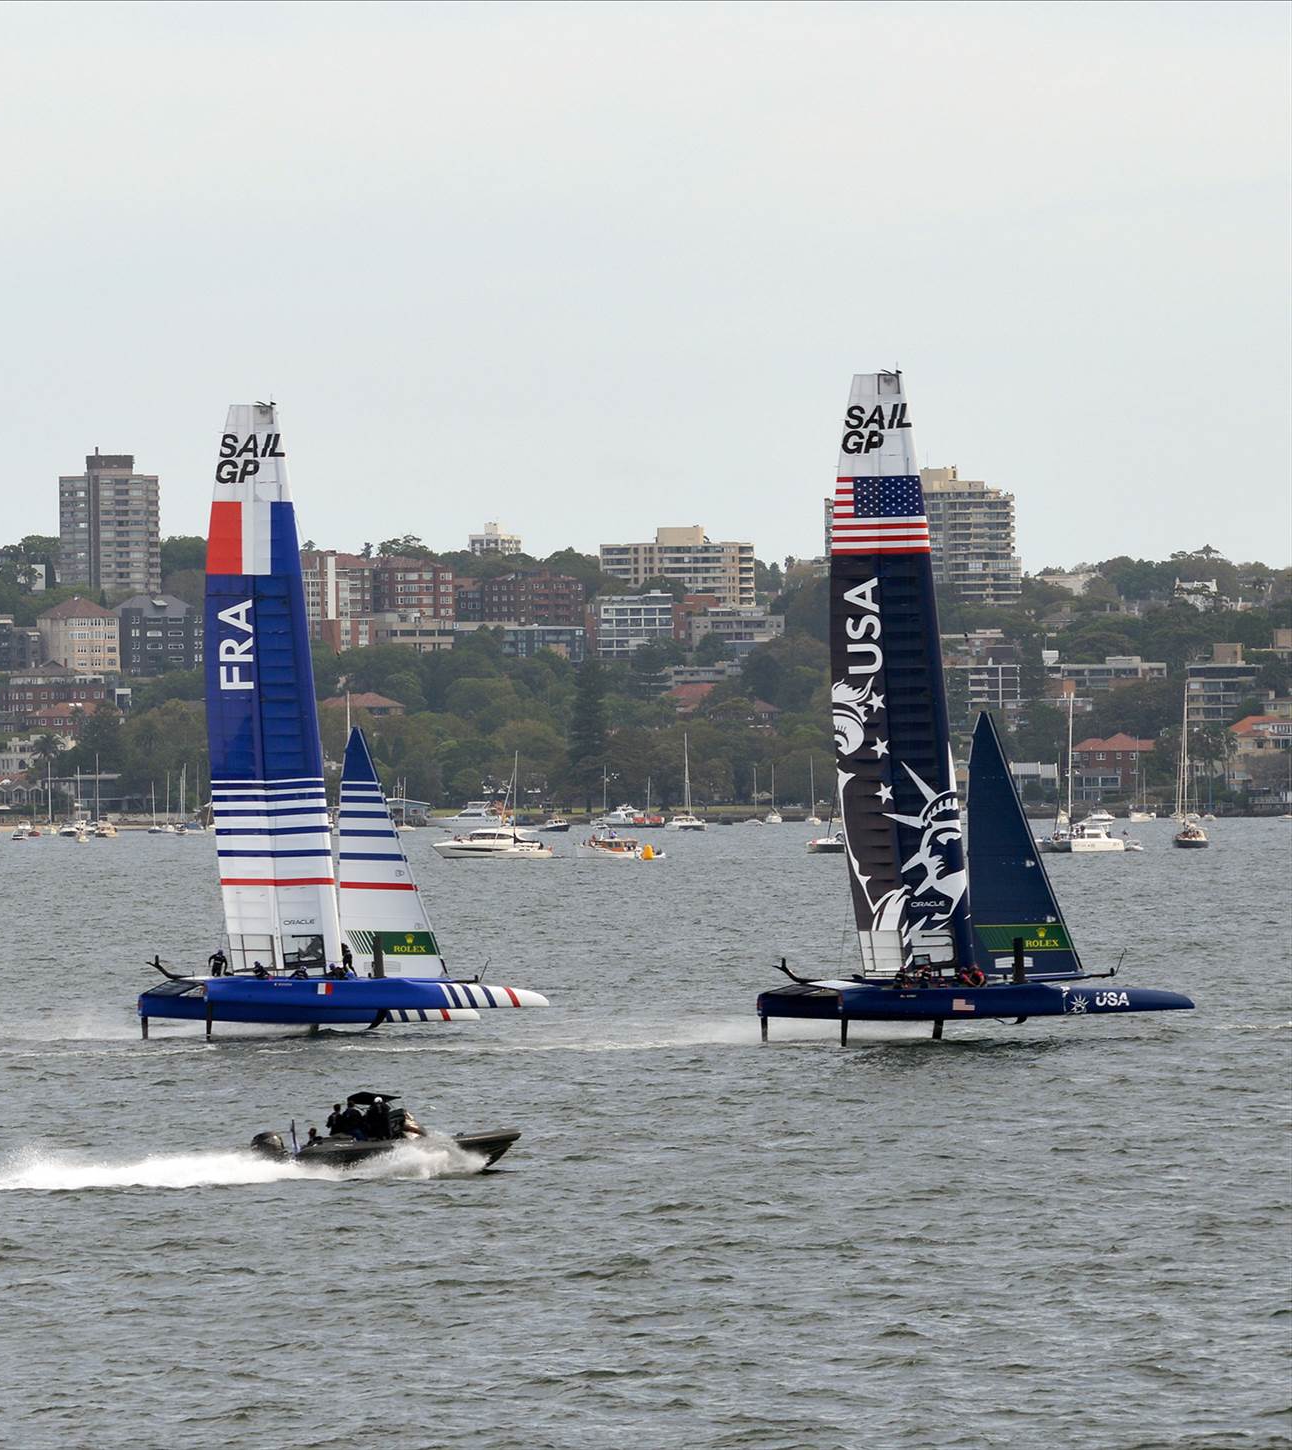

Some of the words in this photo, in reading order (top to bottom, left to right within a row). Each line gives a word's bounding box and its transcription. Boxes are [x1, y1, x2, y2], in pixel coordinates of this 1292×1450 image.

[844, 402, 912, 430] SAIL
[219, 433, 285, 458] SAIL
[841, 430, 884, 455] GP
[215, 459, 260, 484] GP
[843, 576, 885, 675] USA
[217, 599, 255, 692] FRA
[910, 900, 946, 908] ORACLE
[283, 918, 316, 926] ORACLE
[393, 945, 426, 953] ROLEX
[1025, 939, 1059, 948] ROLEX
[1095, 991, 1130, 1007] USA
